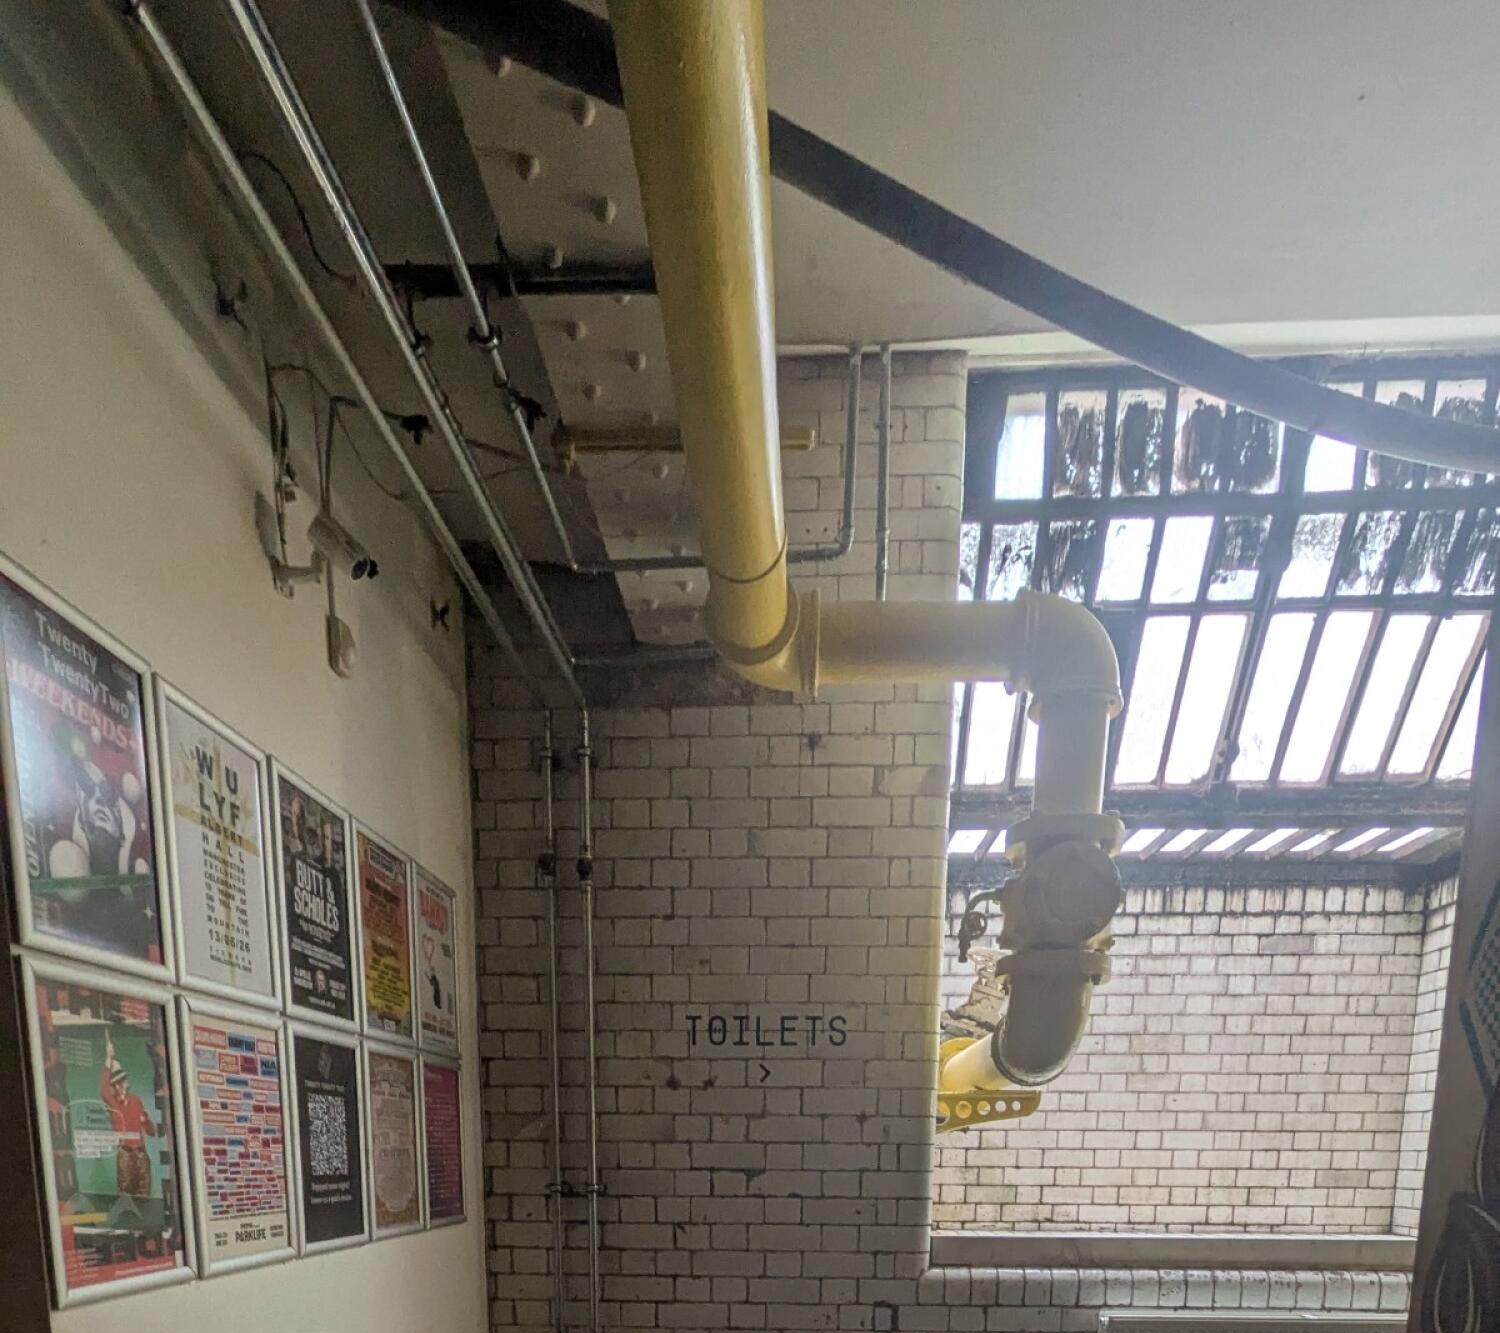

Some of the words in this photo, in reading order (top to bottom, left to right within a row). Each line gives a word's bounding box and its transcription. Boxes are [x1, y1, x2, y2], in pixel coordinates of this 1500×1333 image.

[34, 609, 97, 675] Twenty
[38, 641, 129, 719] TwentyTwo
[6, 656, 128, 749] WEEKENDS
[199, 782, 240, 827] LYF
[201, 815, 243, 847] ALBERT
[202, 832, 244, 863] HALL
[203, 849, 245, 873] MANCHESTER
[204, 871, 246, 896] CELEBRATING
[296, 859, 323, 897] BUTT
[326, 877, 336, 904] &
[294, 885, 339, 932] SCHOLES
[207, 914, 249, 937] MOUNTAIN
[685, 1015, 848, 1047] TOILETS
[235, 1228, 267, 1243] PARKLIFE
